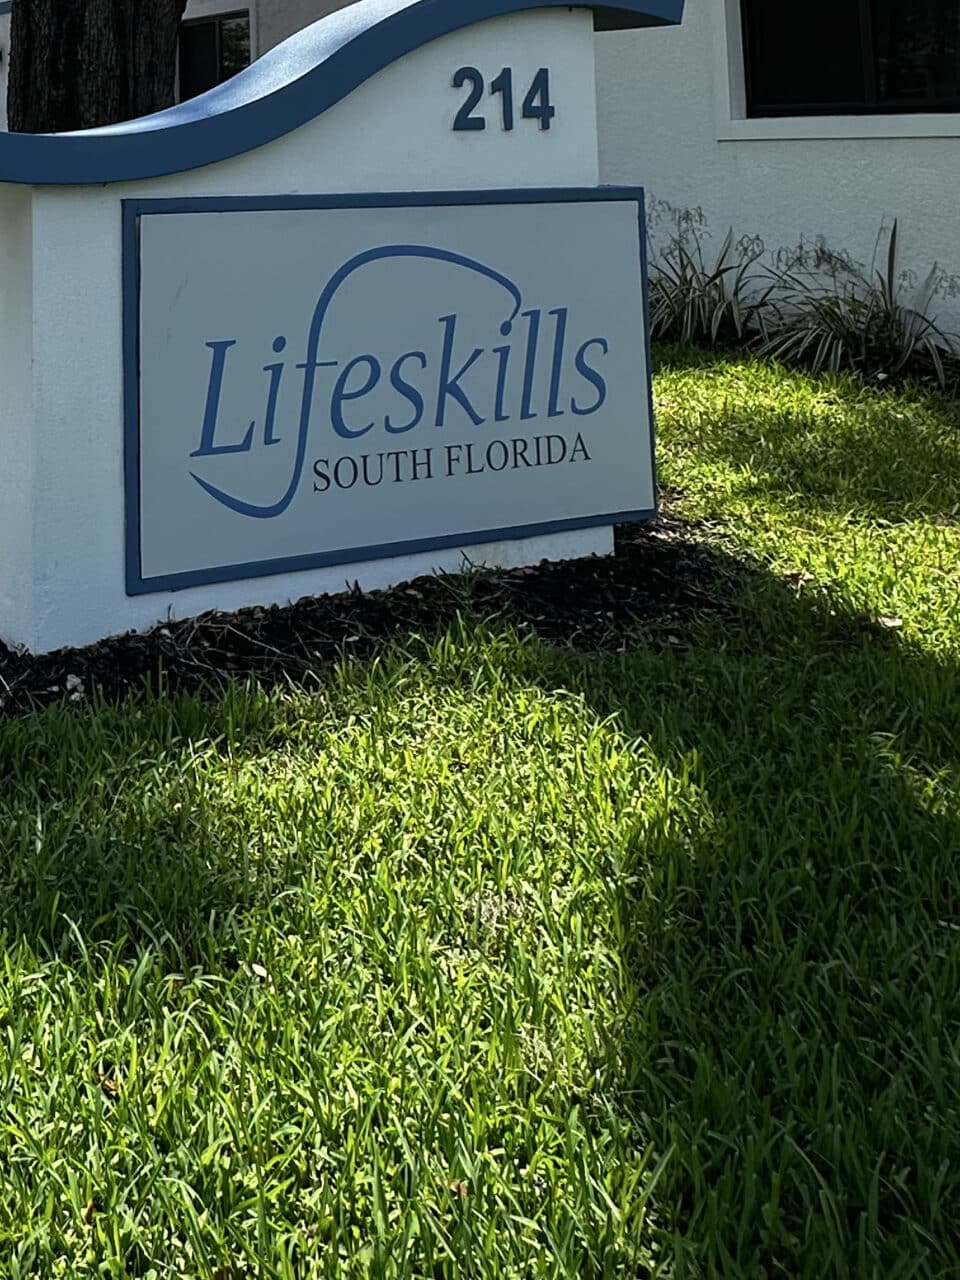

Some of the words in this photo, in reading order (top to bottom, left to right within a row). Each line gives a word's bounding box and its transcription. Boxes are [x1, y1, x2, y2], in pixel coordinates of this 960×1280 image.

[451, 67, 555, 132] 214
[189, 244, 609, 518] Lifeskills
[312, 447, 433, 492] SOUTH
[444, 432, 592, 477] FLORIDA
